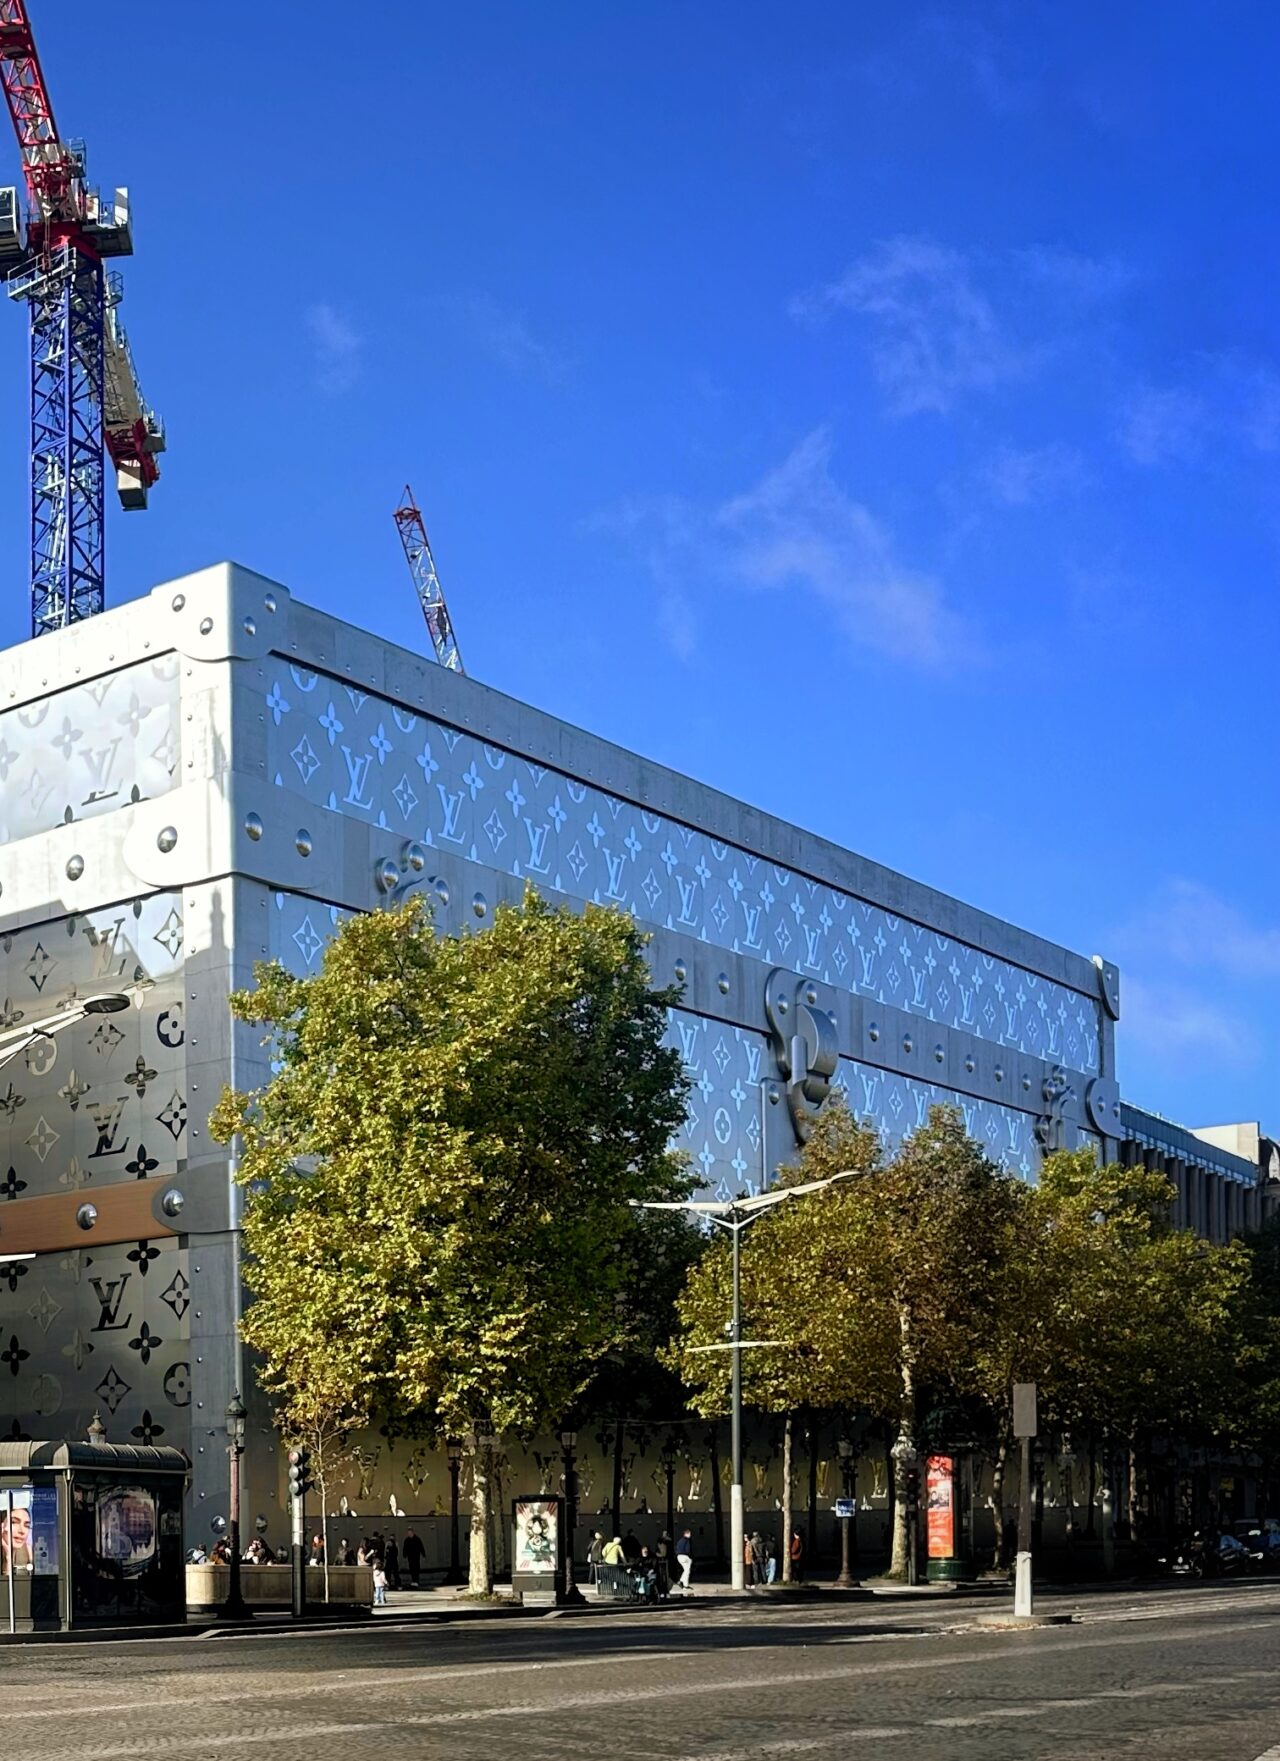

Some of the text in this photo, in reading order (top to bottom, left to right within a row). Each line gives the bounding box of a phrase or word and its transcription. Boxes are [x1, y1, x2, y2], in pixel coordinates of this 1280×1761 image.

[341, 745, 373, 810] LV
[436, 784, 466, 844] LV
[524, 817, 551, 874] LV
[603, 848, 627, 902] LV
[676, 875, 699, 926] LV
[741, 901, 762, 950] LV
[803, 924, 822, 971] LV
[858, 945, 877, 990] LV
[910, 966, 927, 1008] LV
[86, 1096, 130, 1158] LV
[88, 1273, 132, 1332] LV
